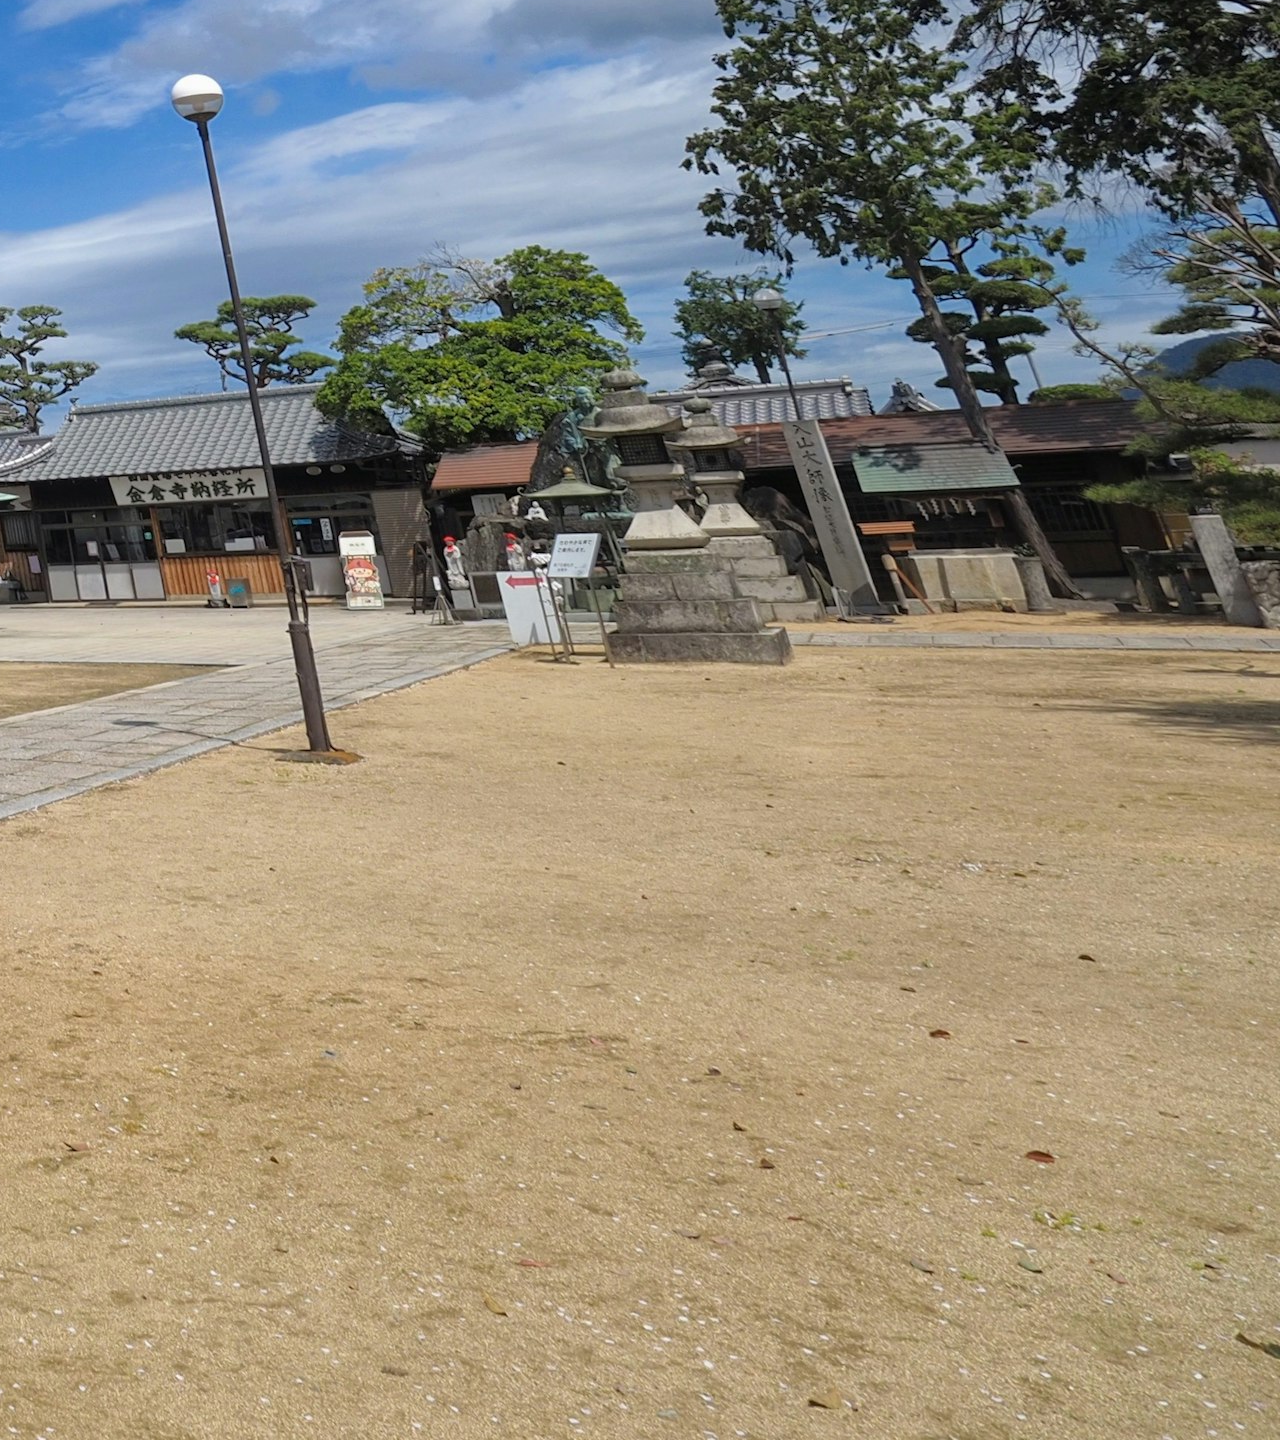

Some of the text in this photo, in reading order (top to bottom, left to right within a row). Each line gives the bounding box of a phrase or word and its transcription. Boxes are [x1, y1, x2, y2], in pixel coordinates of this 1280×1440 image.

[126, 478, 256, 503] 金倉寺納経所
